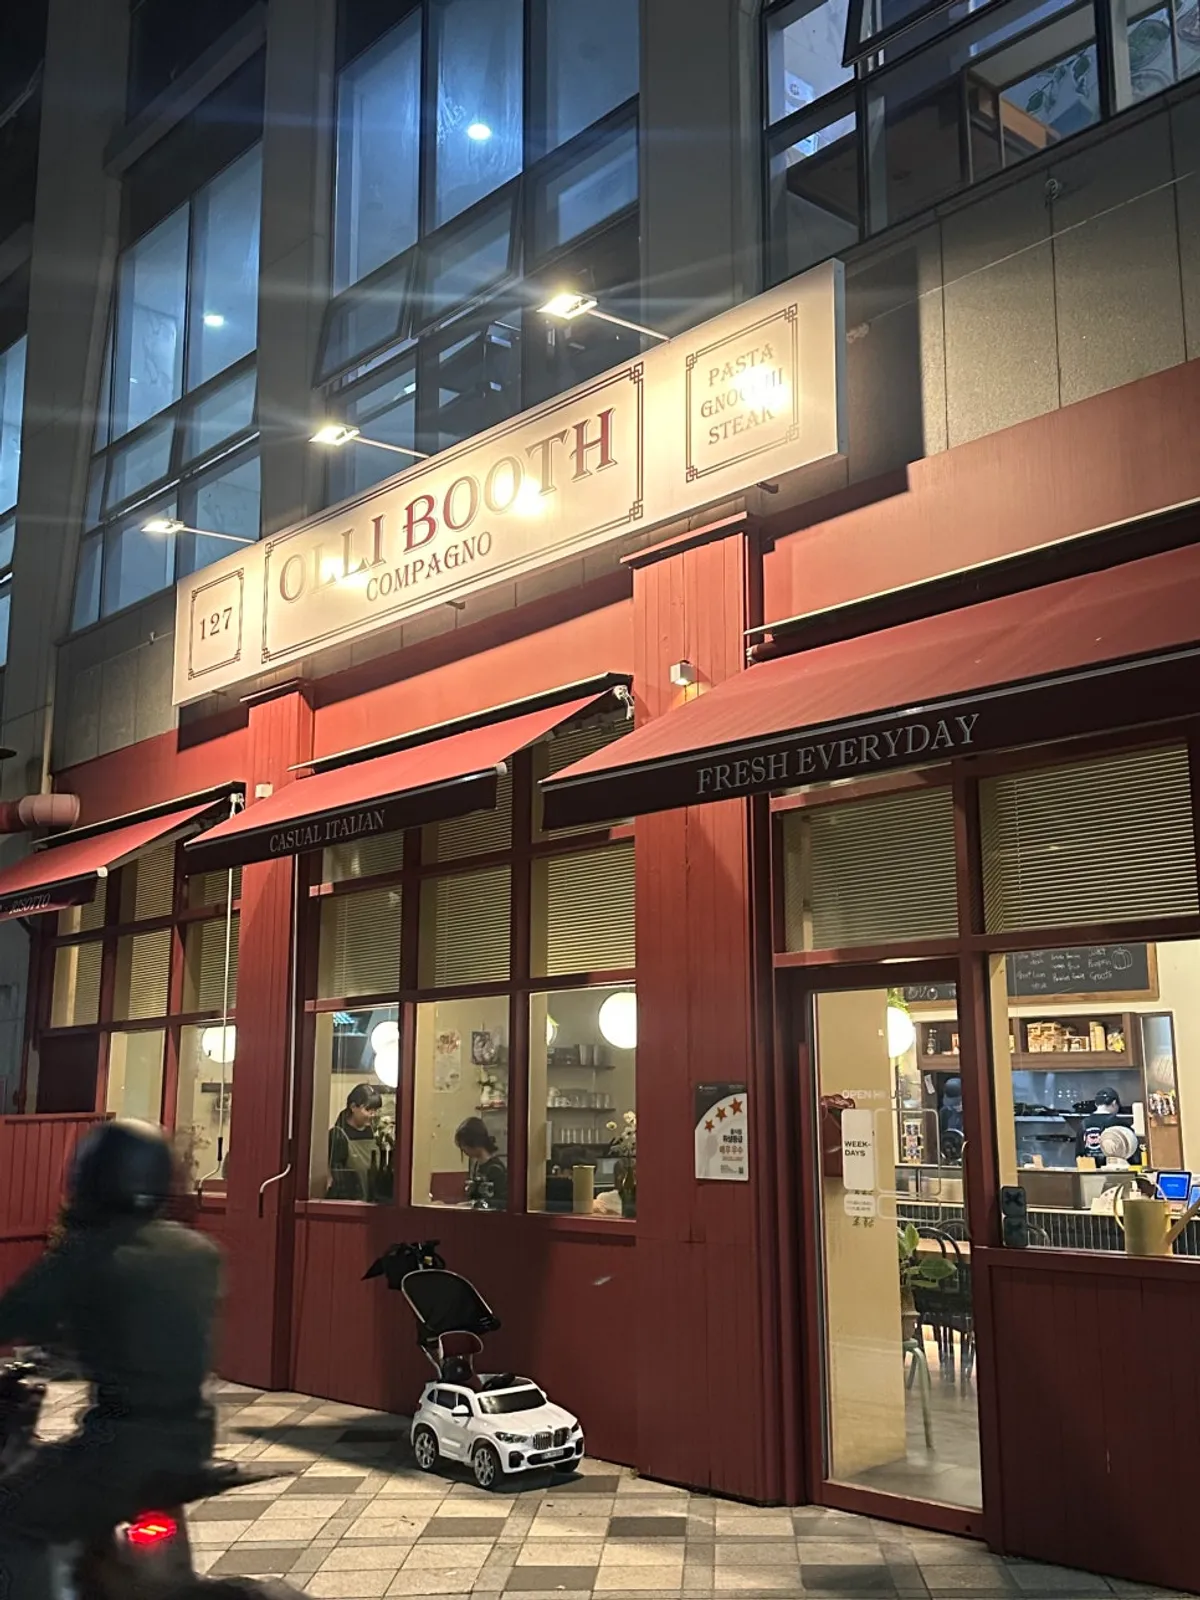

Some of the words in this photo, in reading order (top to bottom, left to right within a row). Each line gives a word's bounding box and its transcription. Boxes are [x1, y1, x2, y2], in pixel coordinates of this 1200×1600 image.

[708, 343, 774, 387] PASTA
[279, 514, 386, 603] OLLI
[403, 407, 618, 555] BOOTH
[366, 531, 492, 602] COMPAGNO
[200, 607, 232, 640] 127
[696, 752, 789, 794] FRESH
[796, 713, 980, 775] EVERYDAY
[269, 825, 321, 852] CASUAL
[325, 809, 385, 840] ITALIAN
[844, 1150, 867, 1158] DAYS
